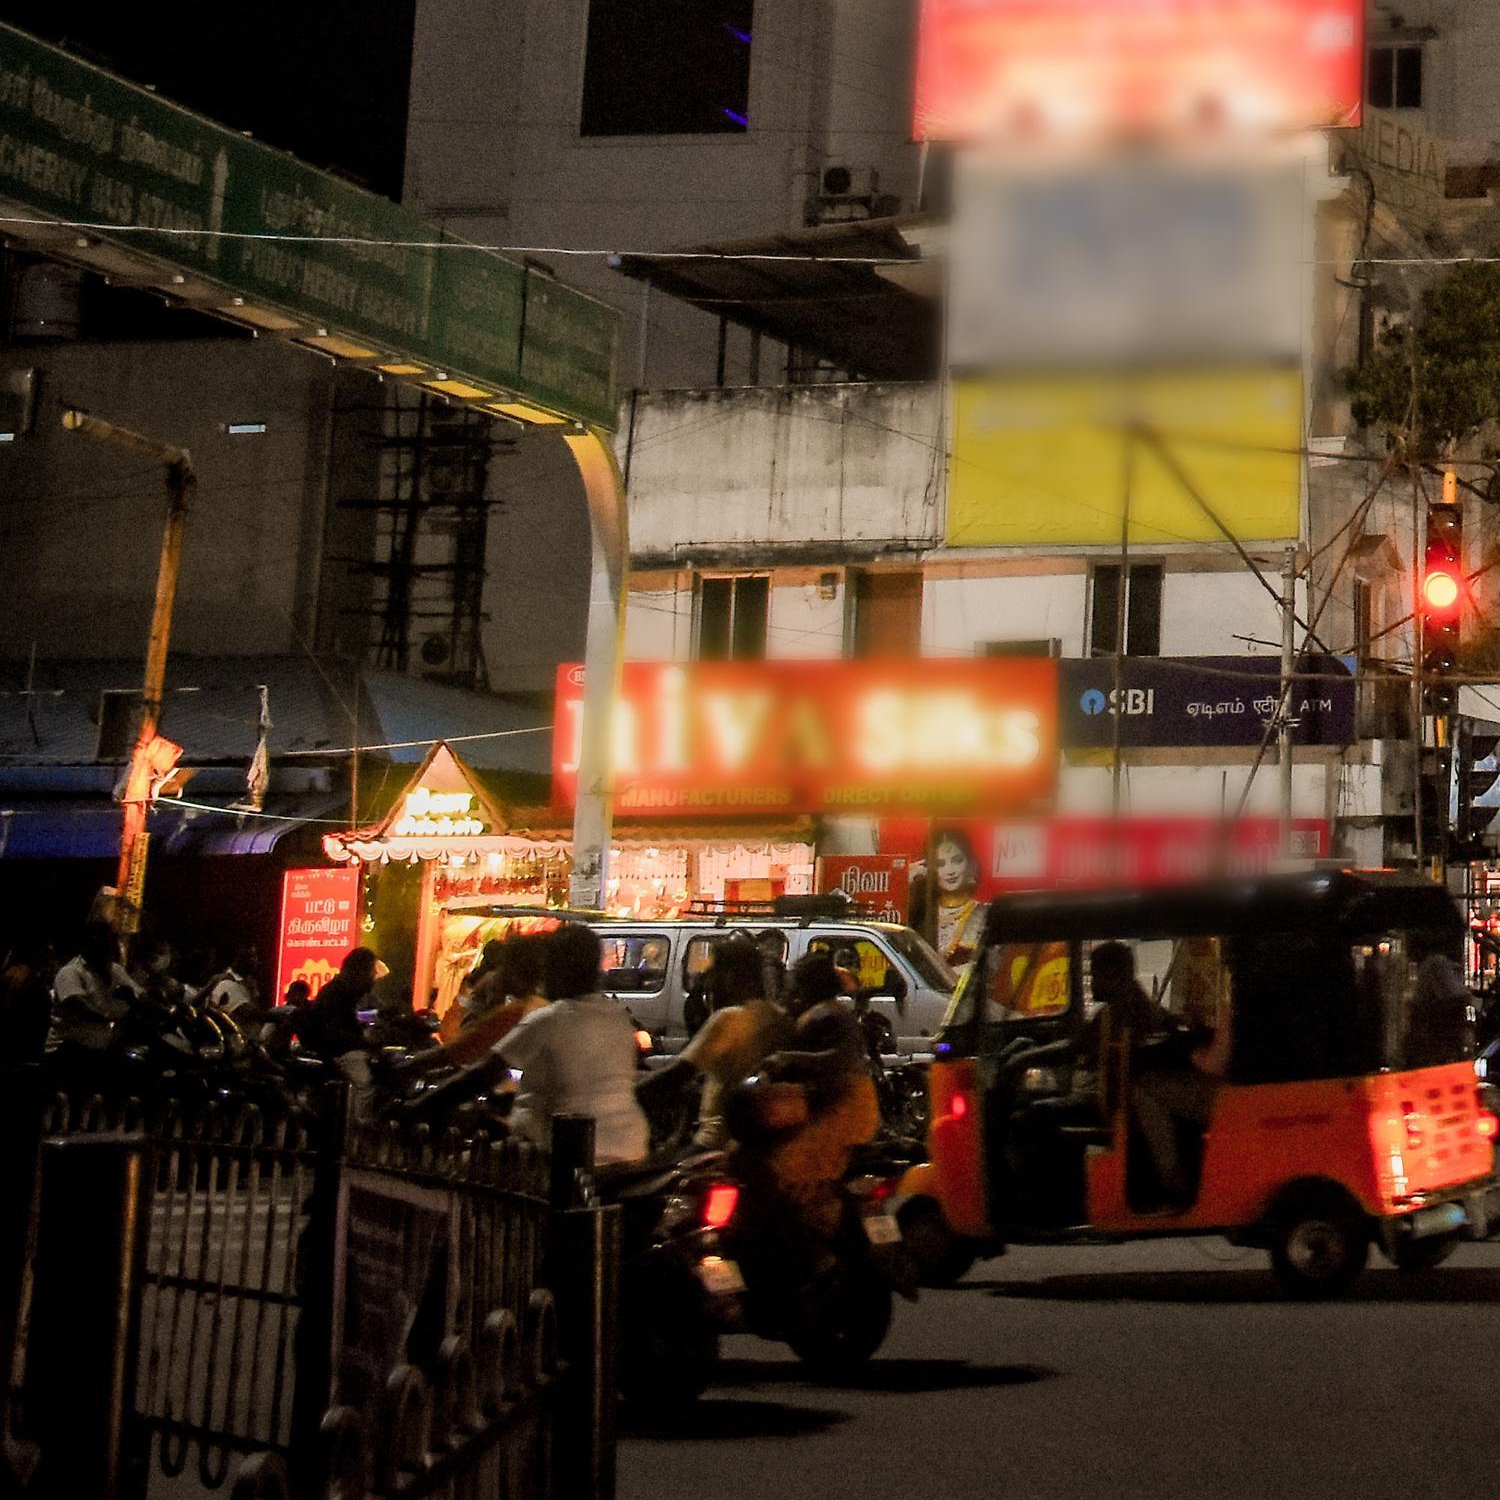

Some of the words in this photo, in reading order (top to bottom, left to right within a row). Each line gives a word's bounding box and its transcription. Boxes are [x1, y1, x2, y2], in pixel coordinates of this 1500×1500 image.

[1108, 688, 1154, 715] SBI
[1300, 698, 1332, 713] ATM
[620, 786, 789, 808] MANUFACTURERS
[287, 916, 350, 935] திருவிழா
